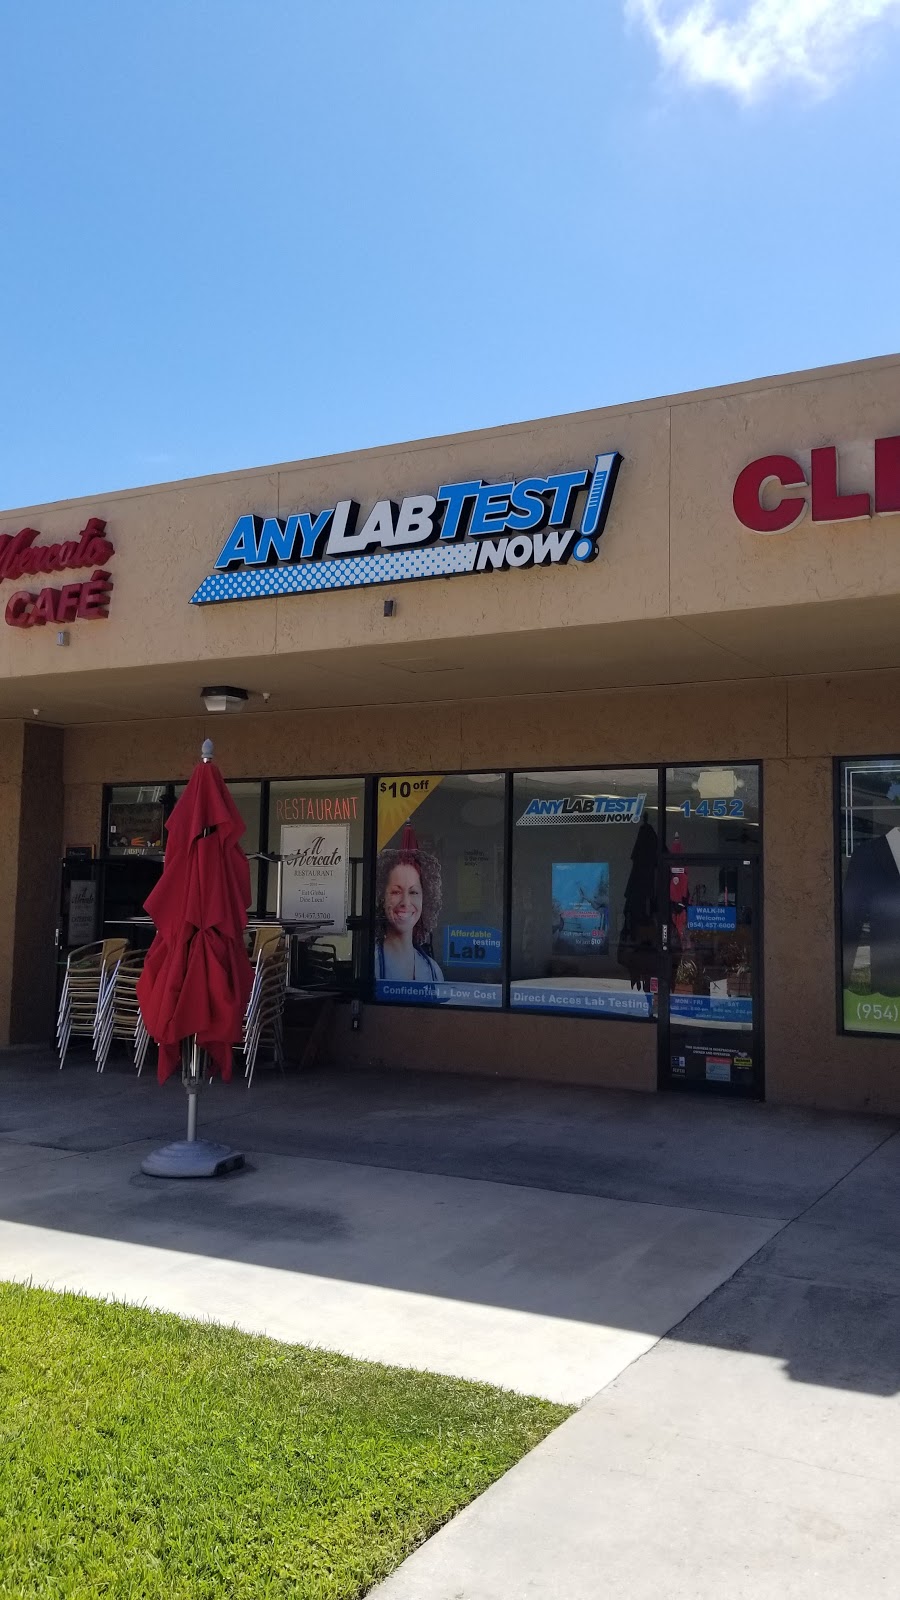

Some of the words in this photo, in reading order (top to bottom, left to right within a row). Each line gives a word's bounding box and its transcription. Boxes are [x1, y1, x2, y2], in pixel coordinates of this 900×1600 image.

[380, 781, 411, 798] $10
[413, 780, 429, 790] off
[276, 797, 358, 821] RESTAURANT
[680, 799, 745, 817] 1452
[450, 930, 492, 938] Affordable
[472, 939, 501, 947] testing
[449, 942, 486, 960] Lab
[383, 985, 440, 998] Confidential
[450, 988, 470, 998] Low
[474, 990, 497, 1000] Cost
[513, 992, 546, 1003] Direct
[585, 996, 605, 1006] Lab
[608, 998, 650, 1011] Testing
[857, 1002, 899, 1022] (954)
